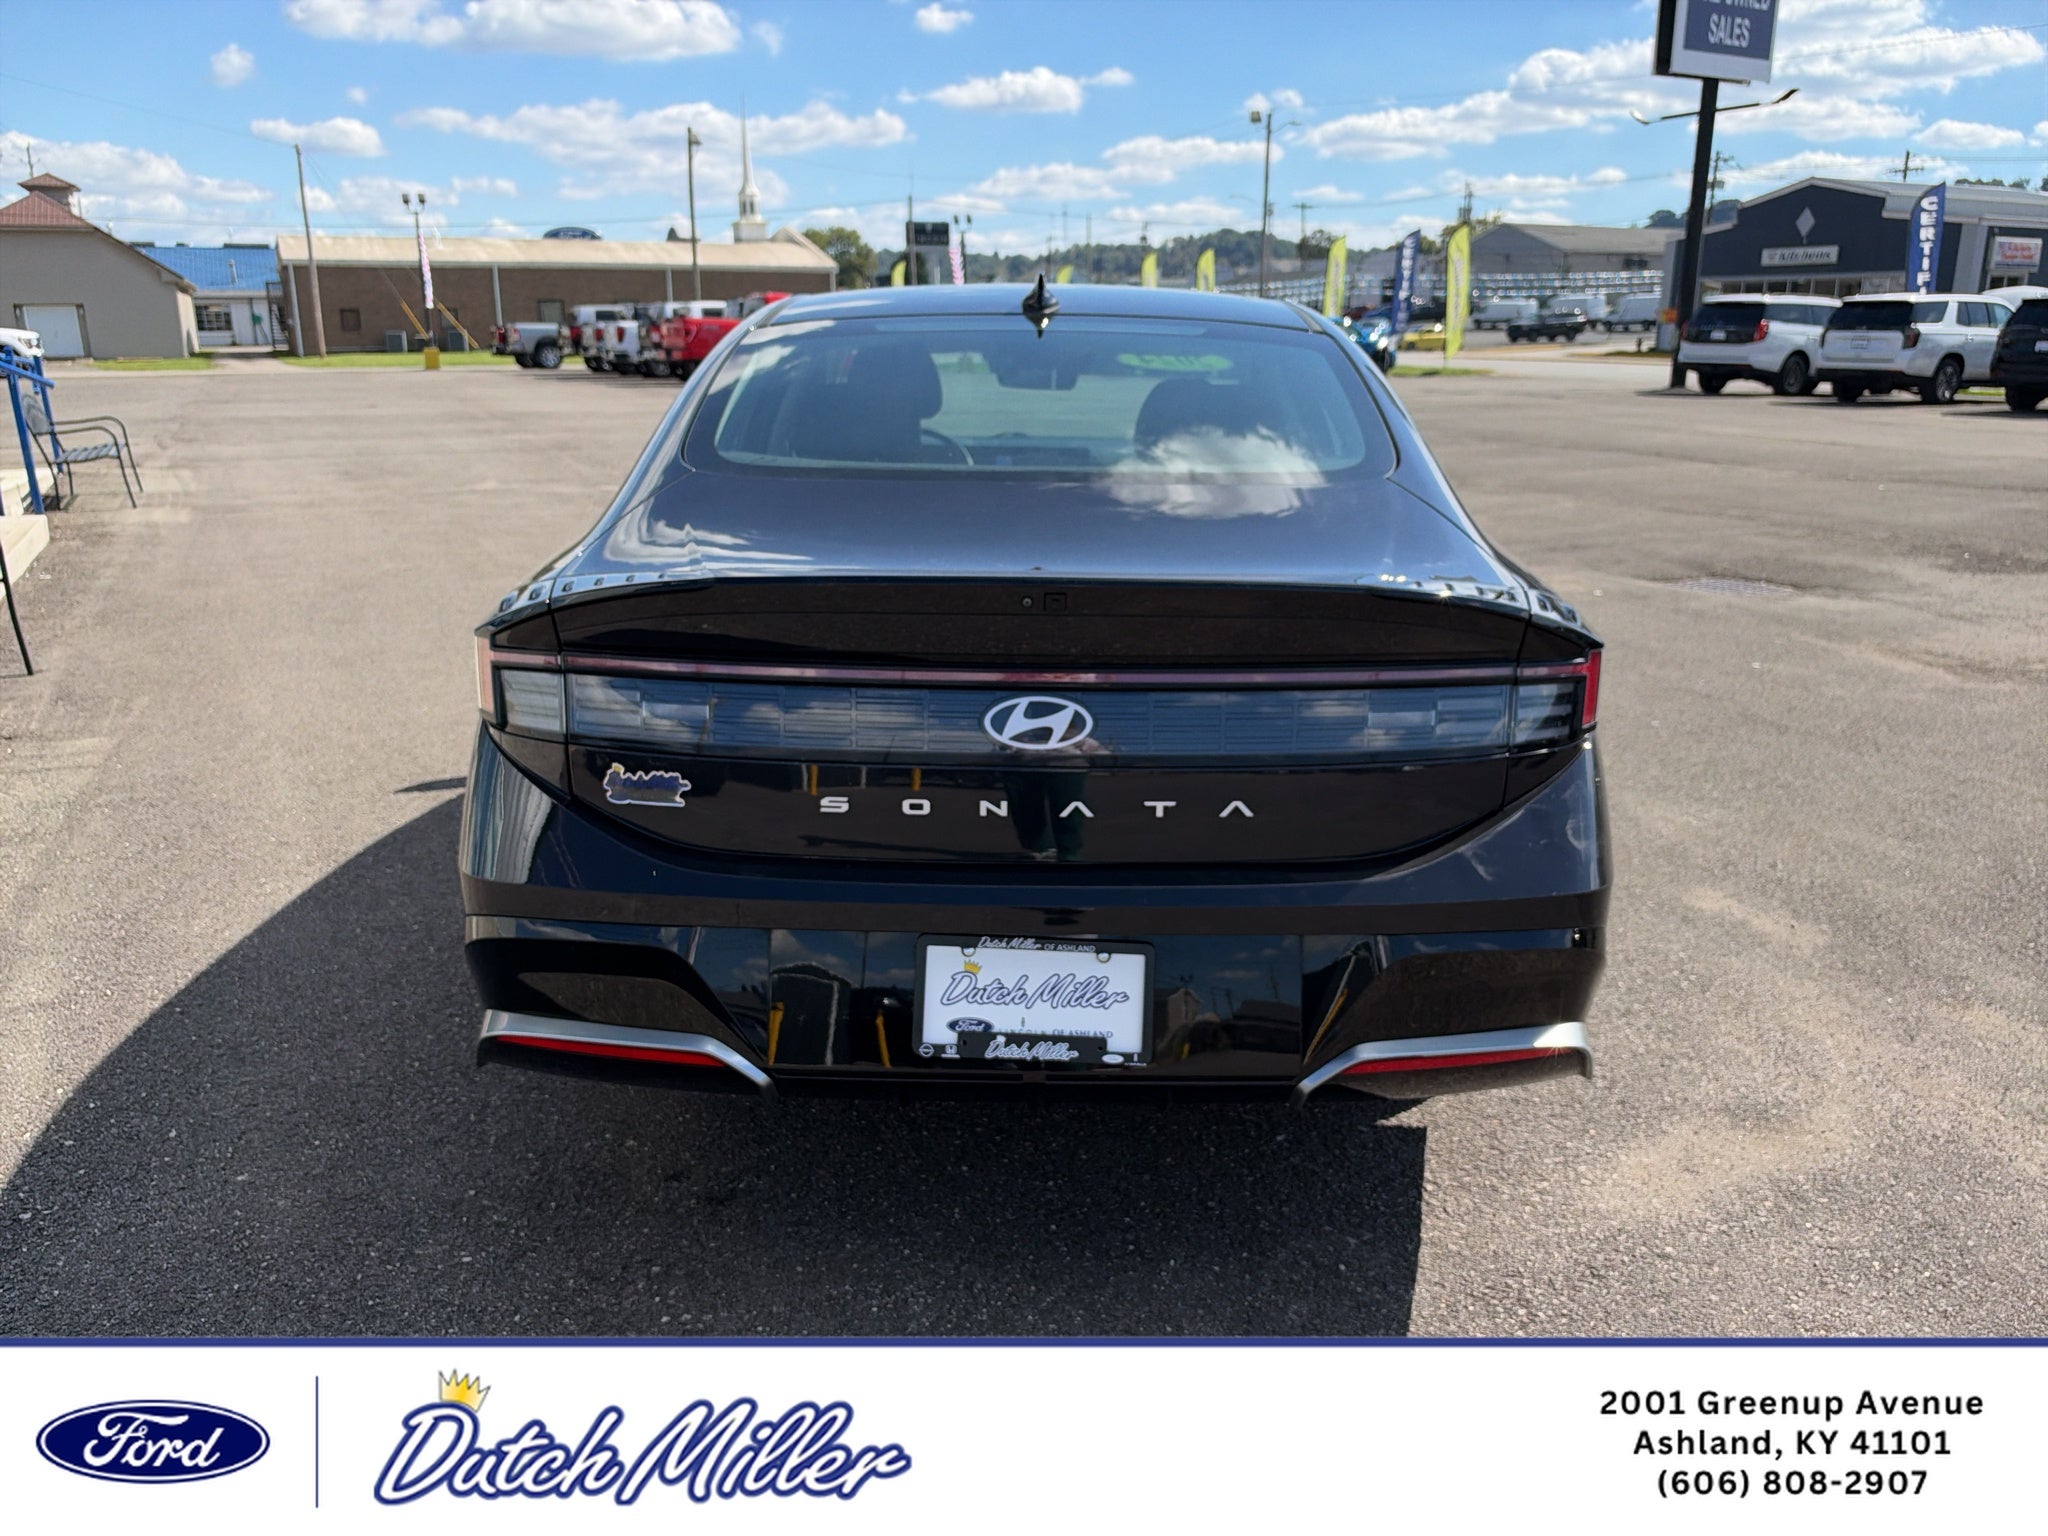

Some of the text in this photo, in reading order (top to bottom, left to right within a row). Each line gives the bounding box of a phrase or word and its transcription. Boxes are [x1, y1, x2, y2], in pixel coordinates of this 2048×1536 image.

[1708, 12, 1751, 48] SALES
[819, 796, 1254, 818] SONATA
[978, 936, 1096, 952] Dutch Miller OF ASHLAND
[940, 971, 1129, 1010] Dutch Miller
[954, 1019, 986, 1032] Ford
[984, 1039, 1080, 1061] Dutch Miller
